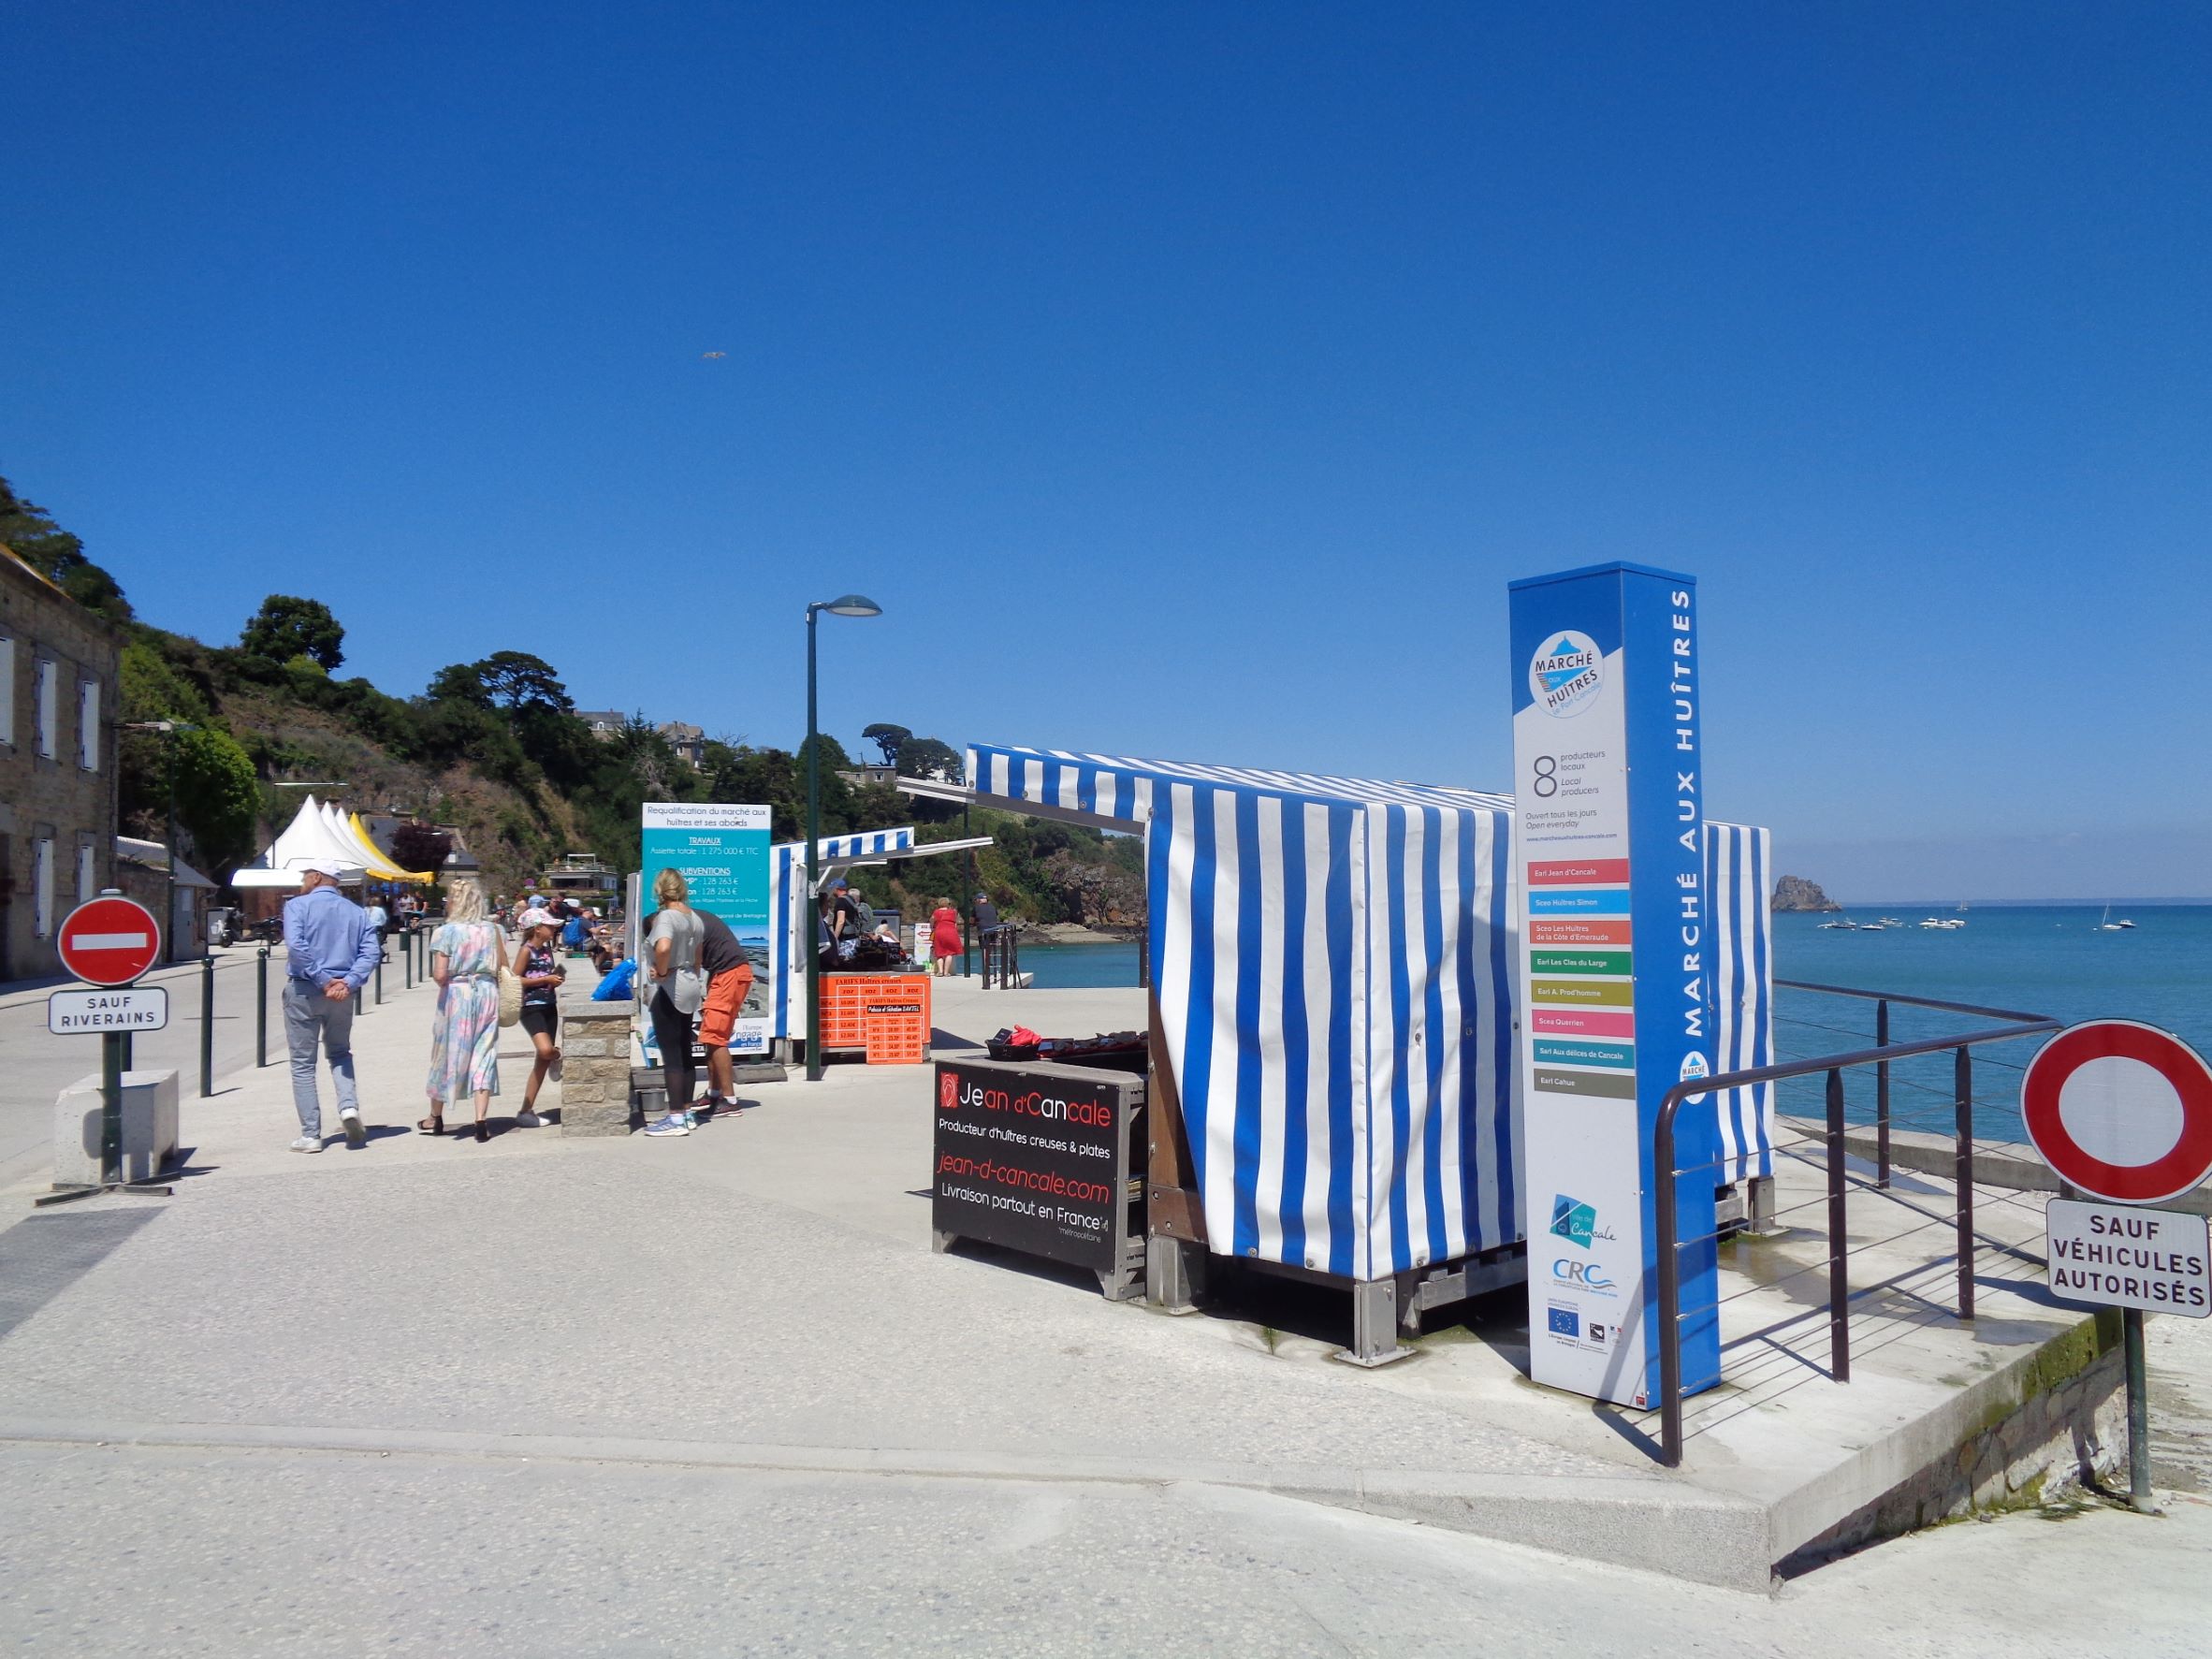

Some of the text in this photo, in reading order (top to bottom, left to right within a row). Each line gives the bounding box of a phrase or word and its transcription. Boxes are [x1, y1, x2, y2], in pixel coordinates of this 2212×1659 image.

[1535, 650, 1593, 672] MARCHÉ
[1547, 670, 1598, 707] HUÎTRES
[1534, 750, 1606, 797] 8 producteurs
[1561, 763, 1585, 771] locaux
[1561, 787, 1599, 797] producers
[648, 806, 706, 816] Requalification
[709, 808, 719, 816] du
[721, 807, 750, 816] marché
[1579, 809, 1597, 819] jours
[1671, 590, 1702, 1037] MARCHÉ AUX HUÎTRES
[1526, 820, 1579, 831] Open everyday
[689, 837, 721, 845] TRAVAUX
[708, 847, 721, 855] 275
[746, 847, 759, 855] TTC
[679, 866, 731, 876] SUBVENTIONS
[1535, 866, 1596, 877] Earl Jean d'Cancale
[1553, 924, 1564, 933] Les
[1588, 960, 1608, 968] Large
[1560, 989, 1601, 997] Prod'homme
[87, 997, 132, 1009] SAUF
[61, 1011, 155, 1026] RIVERAINS
[1539, 1047, 1552, 1055] Sarl
[1552, 1048, 1565, 1056] Aux
[1565, 1049, 1588, 1058] délices
[1597, 1052, 1624, 1060] Cancale
[1540, 1077, 1553, 1085] Earl
[959, 1082, 1112, 1127] Jean d'Cancale
[939, 1117, 1111, 1159] Producteur d'huîtres creuses & plates
[937, 1151, 1110, 1204] jean-d-cancale.com
[941, 1182, 990, 1206] Livraison
[992, 1193, 1036, 1216] partout
[1039, 1205, 1054, 1219] en
[1569, 1223, 1617, 1242] Cancale
[2089, 1215, 2161, 1241] SAUF
[2053, 1237, 2203, 1276] VÉHICULES
[1553, 1259, 1602, 1285] CRC
[2054, 1268, 2205, 1306] AUTORISÉS
